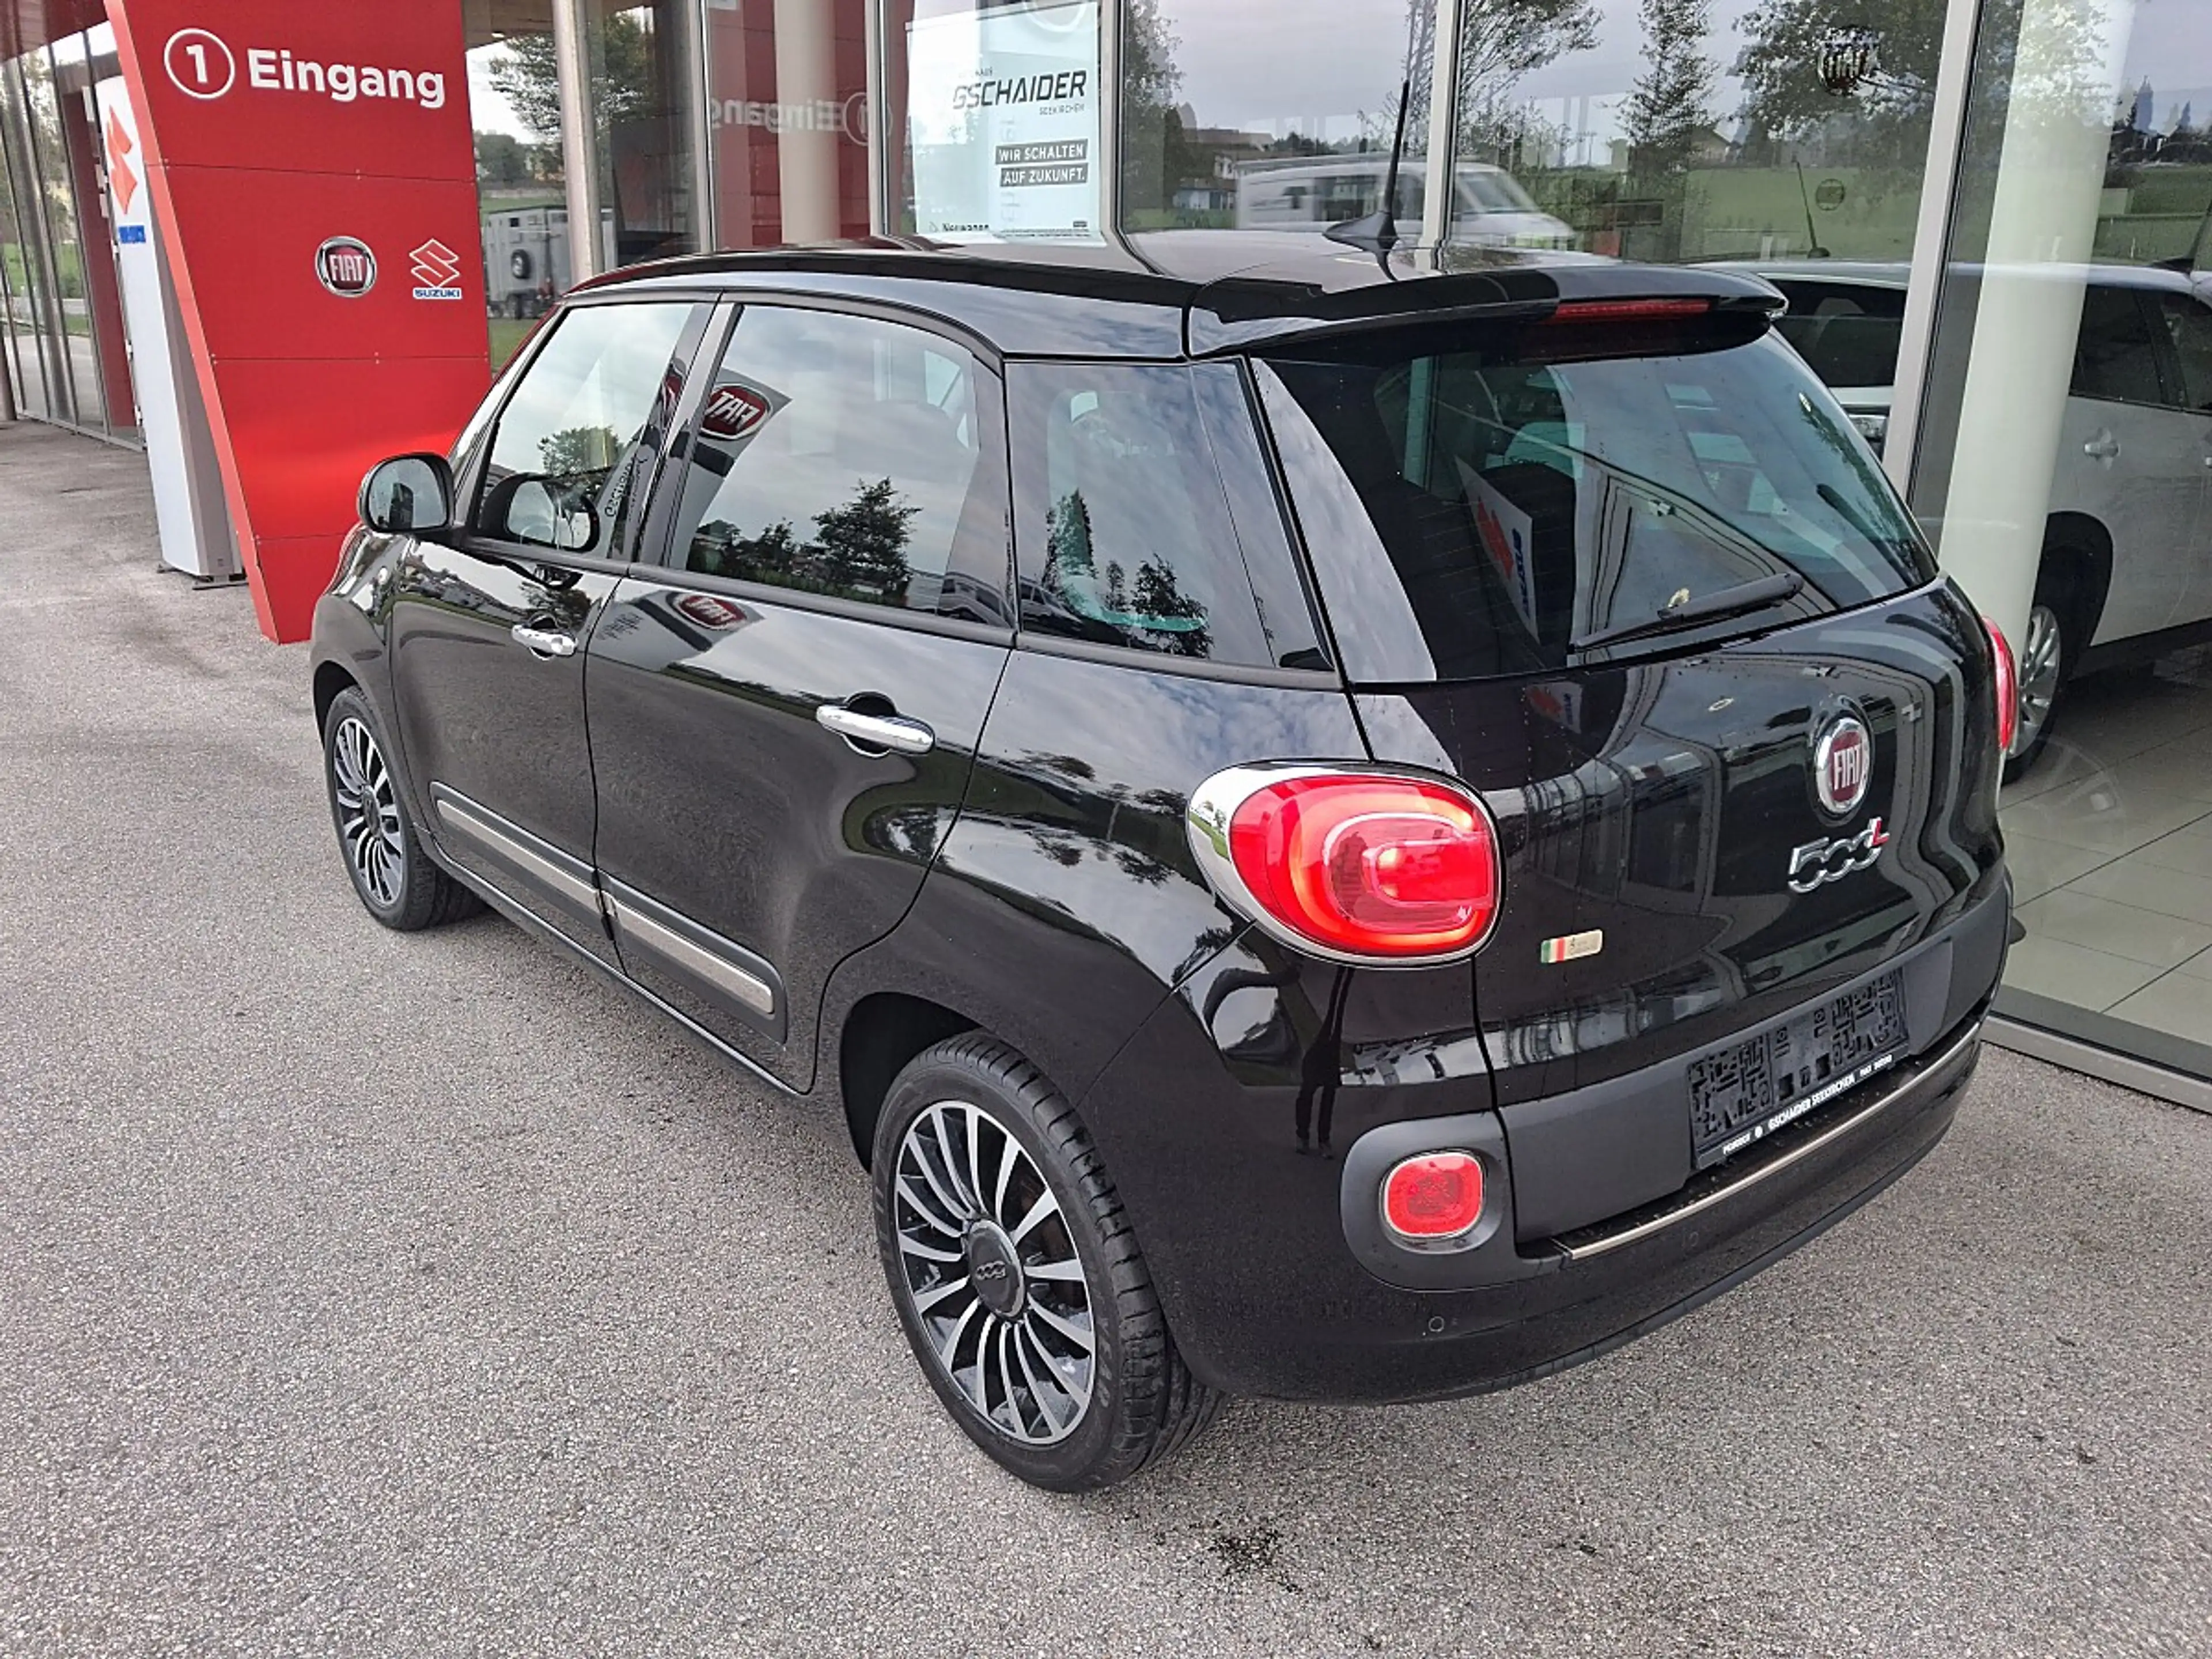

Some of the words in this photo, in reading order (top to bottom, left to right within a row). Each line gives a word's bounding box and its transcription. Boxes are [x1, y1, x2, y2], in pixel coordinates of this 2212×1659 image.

[185, 43, 209, 84] 1
[247, 48, 446, 109] Eingang
[952, 69, 1087, 110] GSCHAIDER
[999, 149, 1021, 162] WIR
[1024, 143, 1084, 161] SCHALTEN
[1003, 171, 1026, 184] AUF
[1028, 167, 1085, 183] ZUKUNFT.
[328, 254, 364, 282] FIAT
[414, 288, 460, 298] SUZUKI
[1833, 743, 1861, 790] FIAT
